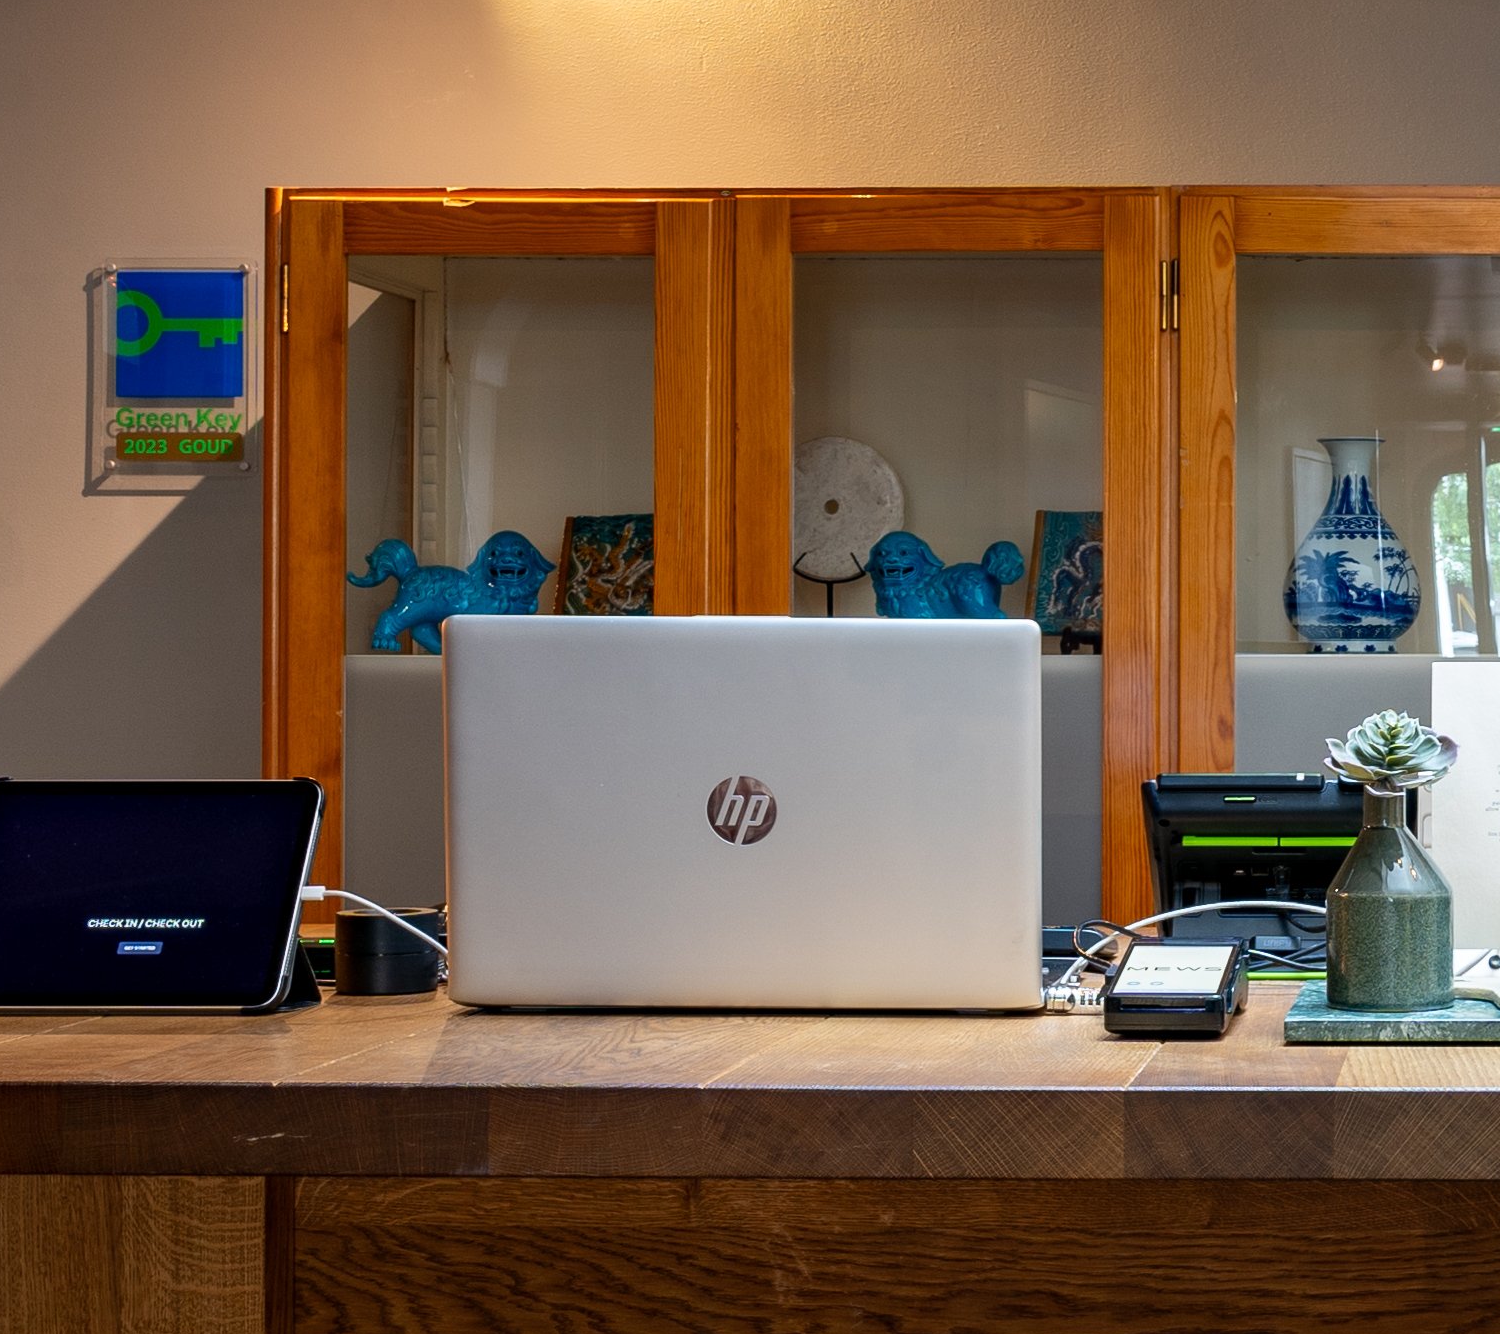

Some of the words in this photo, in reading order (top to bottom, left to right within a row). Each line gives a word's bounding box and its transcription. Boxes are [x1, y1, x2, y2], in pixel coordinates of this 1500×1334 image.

[115, 406, 189, 428] Green
[196, 407, 242, 433] Key
[123, 439, 168, 454] 2023
[178, 439, 234, 454] GOUD
[714, 775, 770, 845] hp
[87, 918, 123, 928] CHECK
[124, 918, 137, 928] IN
[145, 918, 180, 928] CHECK
[181, 919, 205, 928] OUT
